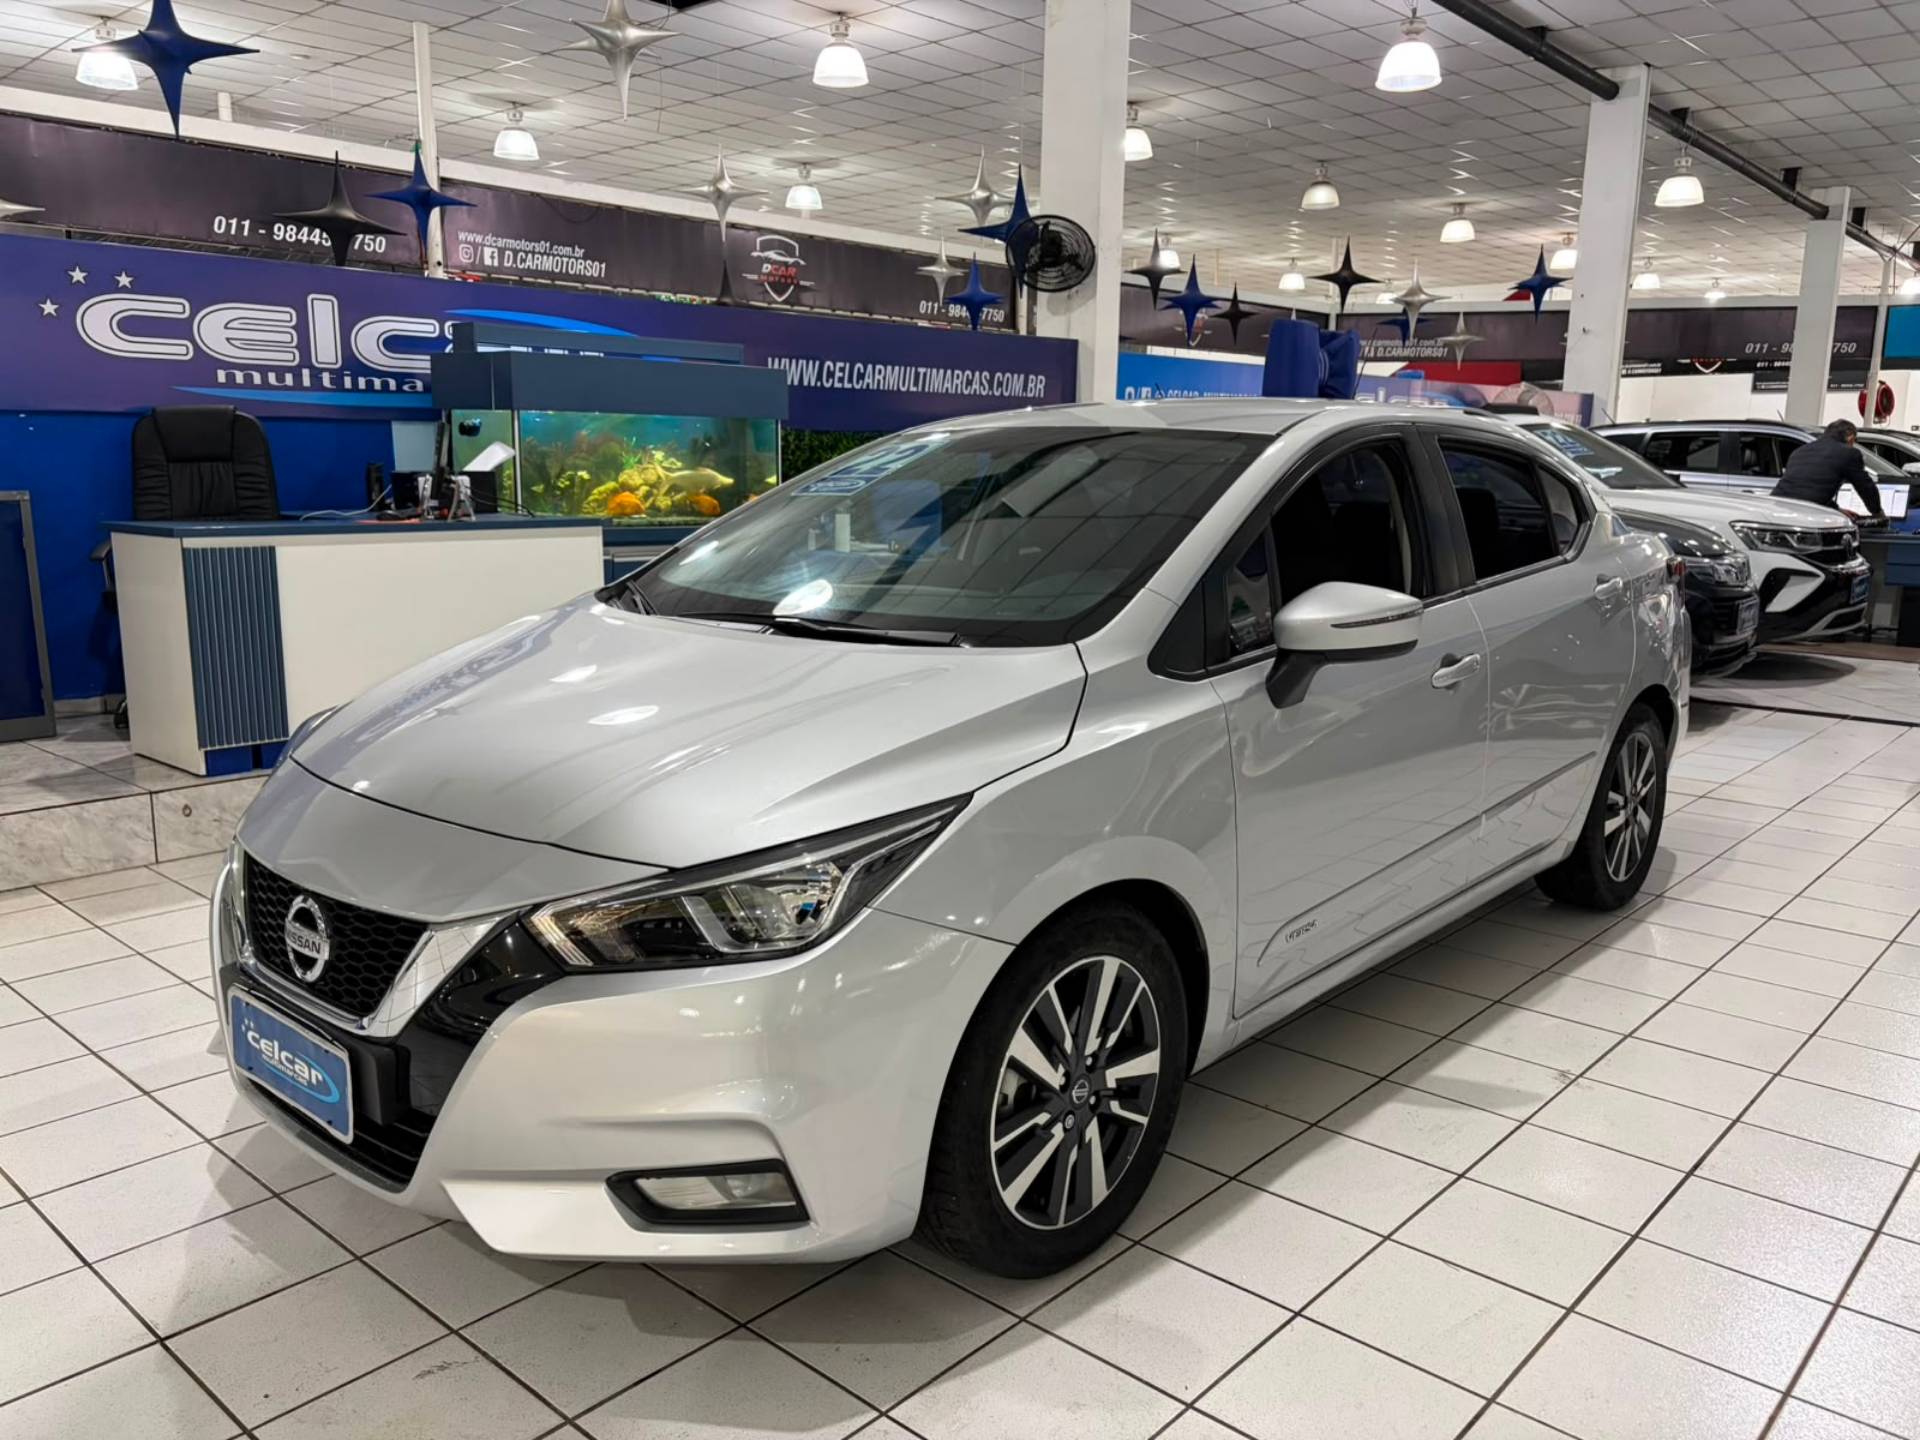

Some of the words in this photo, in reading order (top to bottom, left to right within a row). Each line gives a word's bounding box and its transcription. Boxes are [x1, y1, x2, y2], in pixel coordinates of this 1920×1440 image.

[213, 215, 251, 237] 011
[457, 230, 585, 258] www.dcarmotors01.com.br
[503, 250, 607, 278] D.CARMOTORS01
[761, 263, 797, 277] DCAR
[919, 300, 938, 315] 011
[76, 292, 458, 374] celc
[1744, 342, 1769, 354] 011
[216, 368, 424, 393] multima
[246, 1029, 323, 1086] celcar
